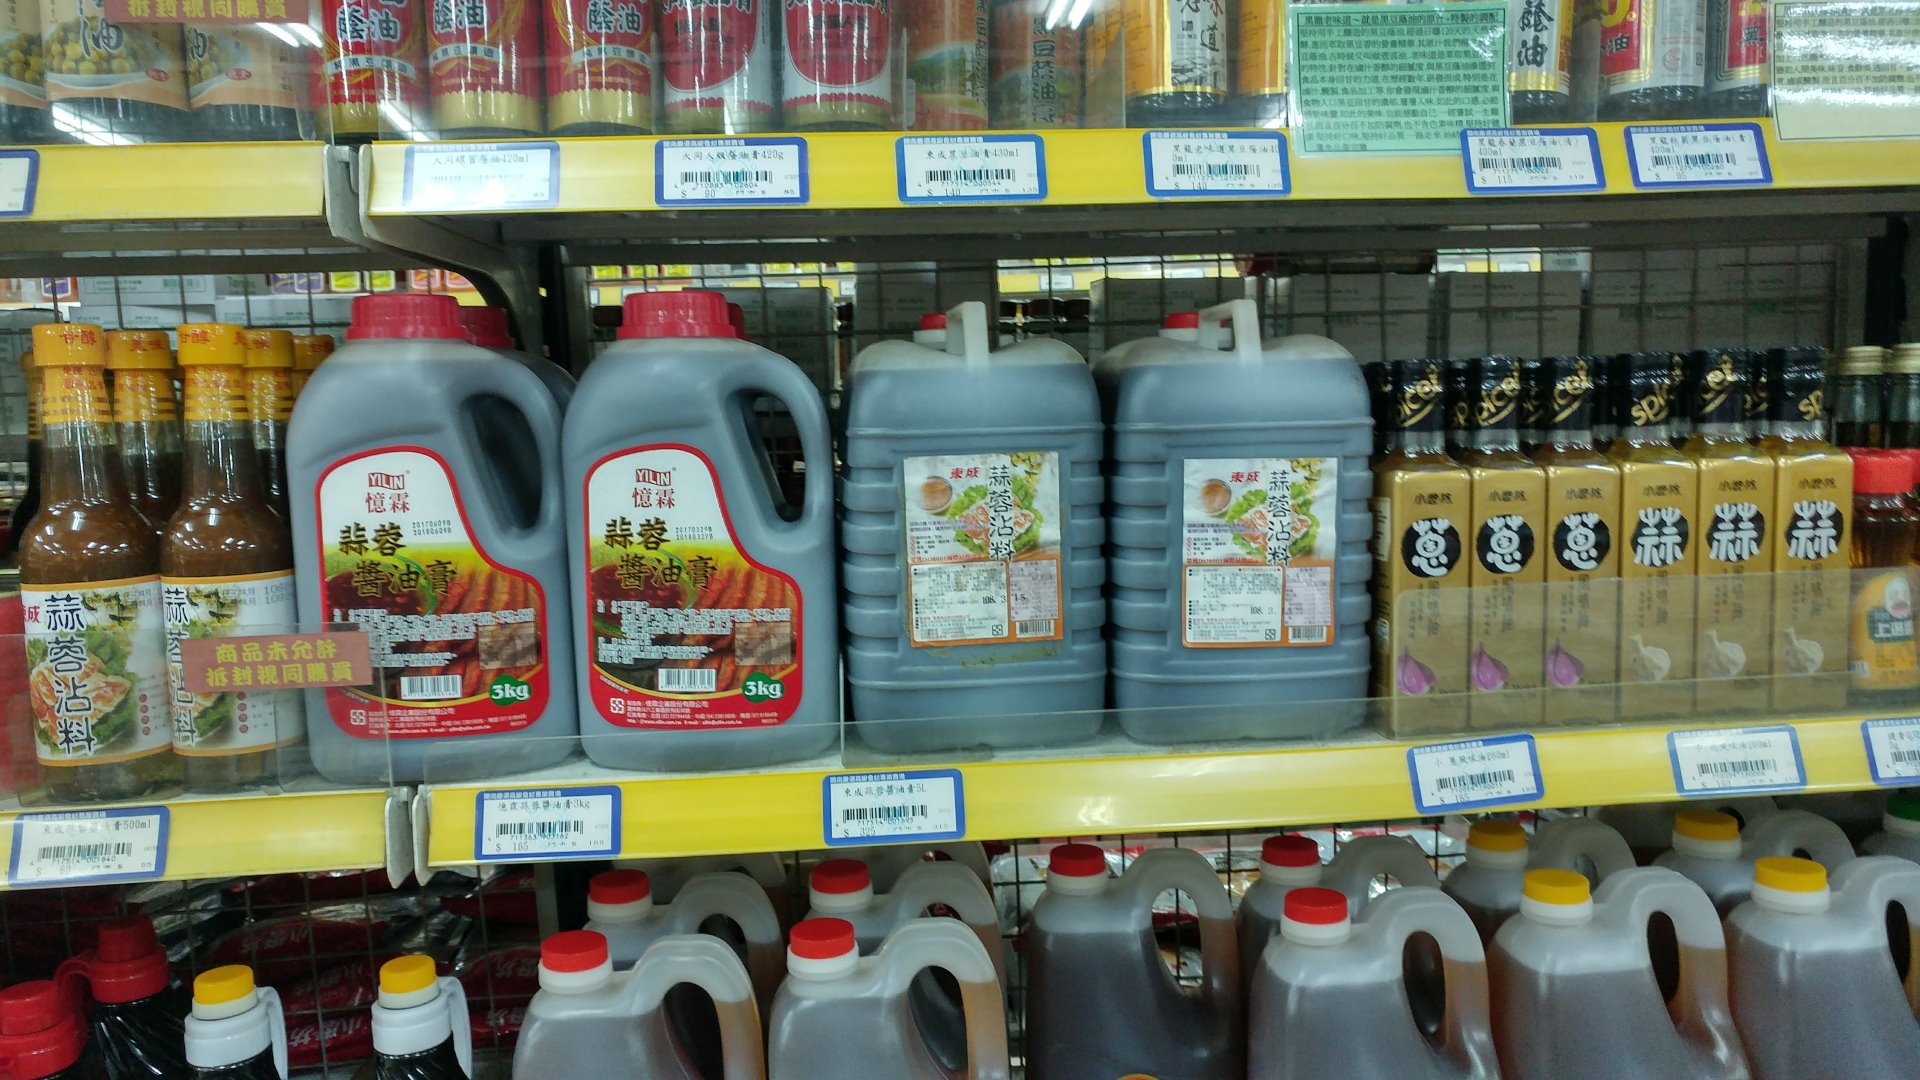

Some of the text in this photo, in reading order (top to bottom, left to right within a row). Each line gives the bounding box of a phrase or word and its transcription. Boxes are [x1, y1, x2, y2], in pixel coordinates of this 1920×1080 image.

[368, 472, 404, 490] YILIN
[635, 468, 671, 487] YILIN
[365, 492, 410, 513] 憶霖
[632, 487, 675, 509] 憶霖
[988, 464, 1015, 561] 蒜蓉沾料
[604, 516, 670, 551] 蒜蓉
[1267, 469, 1292, 566] 蒜蓉沾料
[1709, 502, 1760, 562] 蒜
[1788, 500, 1838, 560] 蒜
[338, 522, 406, 557] 蒜蓉
[1633, 507, 1684, 567] 蒜
[352, 560, 457, 598] 醬油膏
[616, 553, 717, 592] 醬油膏
[216, 639, 337, 664] 商品未允許
[45, 592, 97, 756] 蒜蓉沾料
[491, 682, 530, 701] 3kg
[744, 680, 783, 699] 3kg
